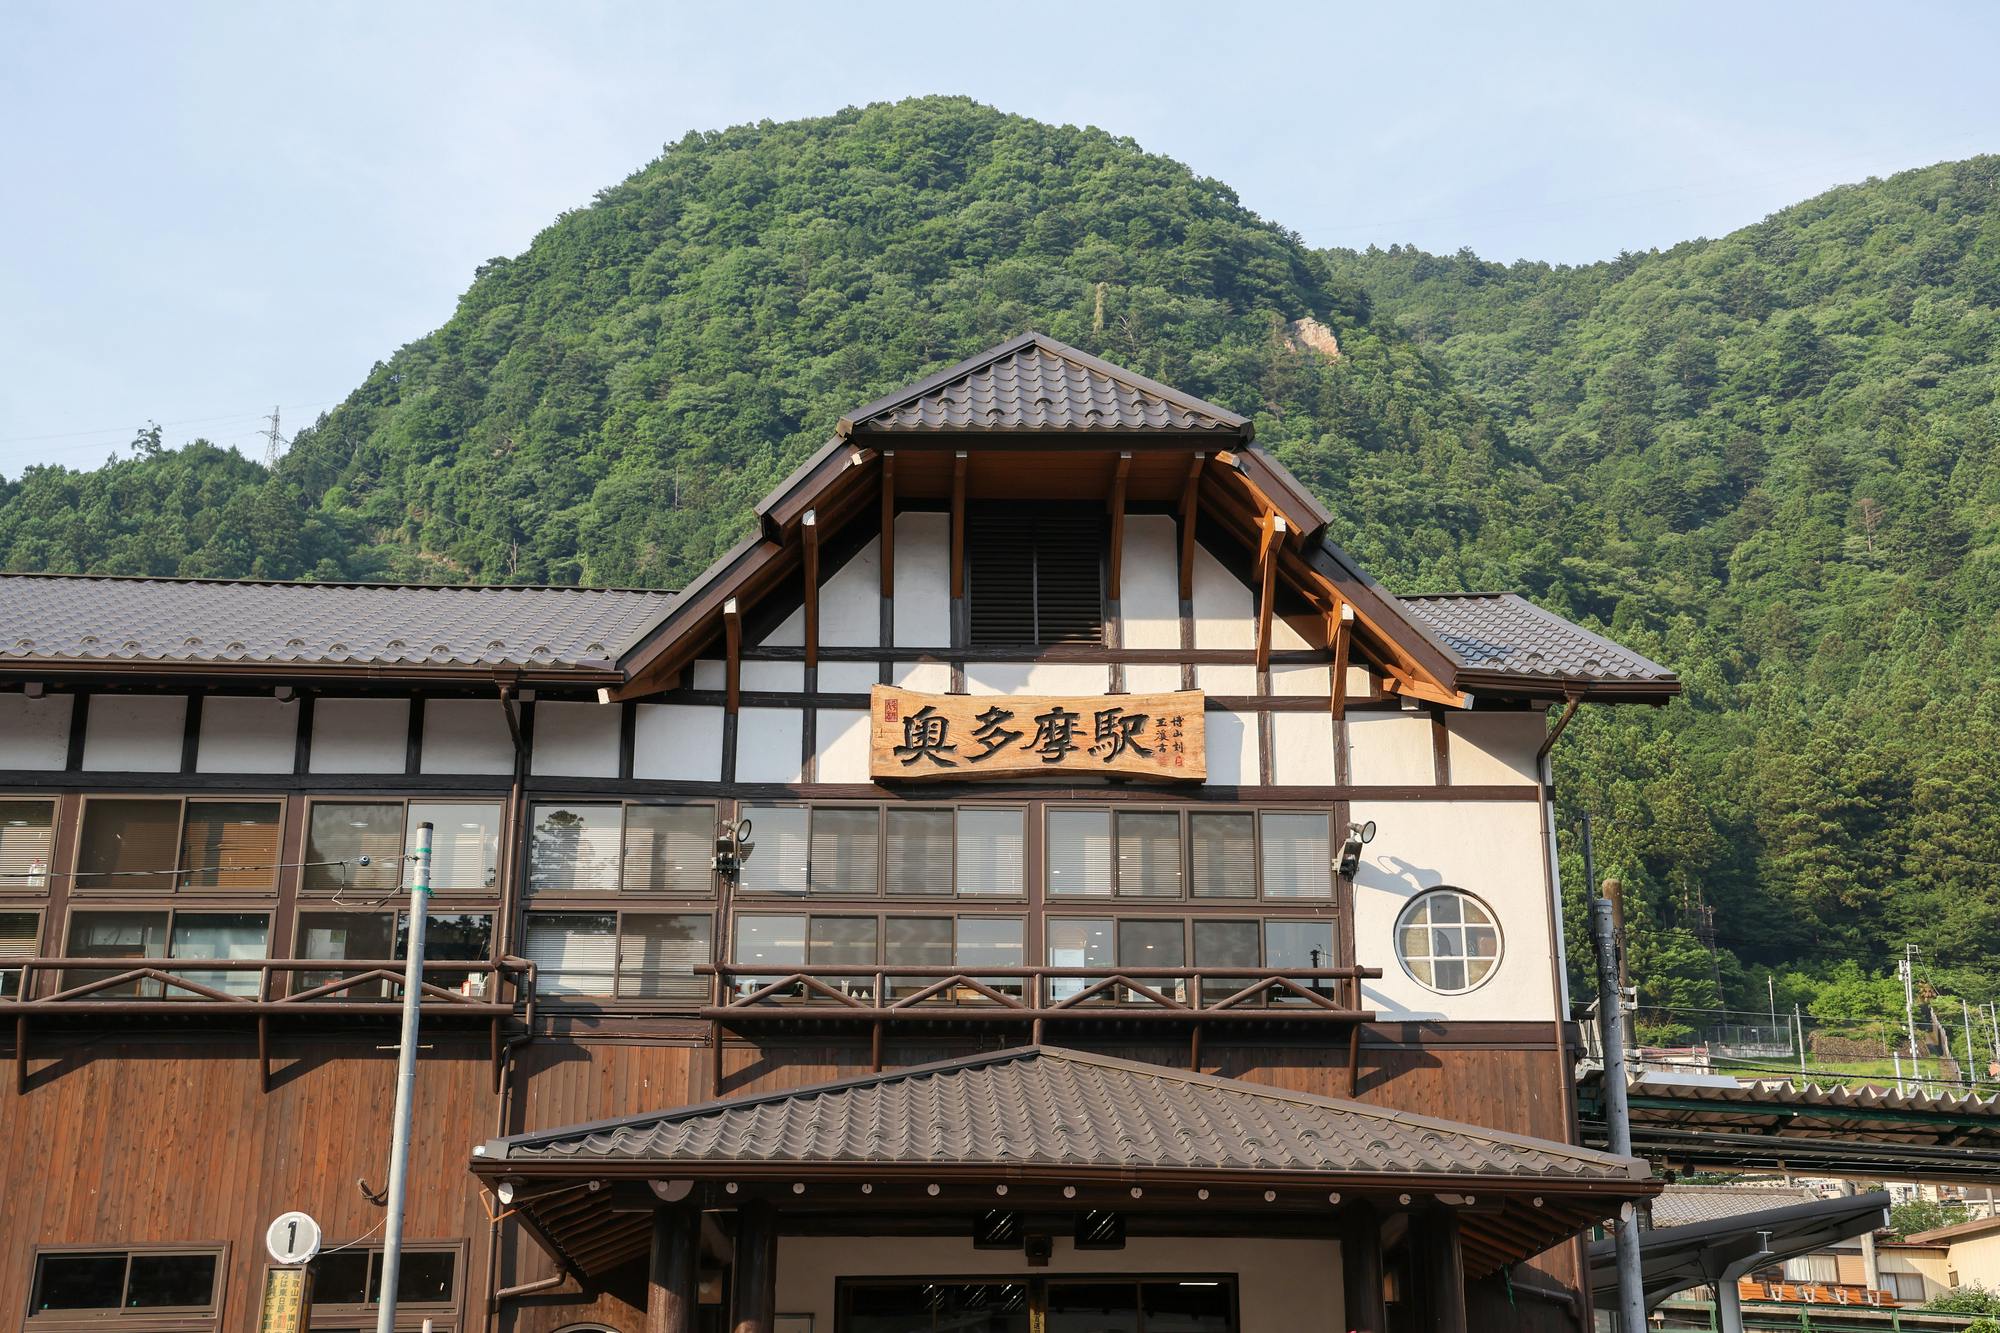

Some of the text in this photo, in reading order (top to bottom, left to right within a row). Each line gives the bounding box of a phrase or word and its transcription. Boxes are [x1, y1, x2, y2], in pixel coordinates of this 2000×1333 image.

[893, 705, 1155, 768] 奥多摩駅
[287, 1221, 297, 1254] 1
